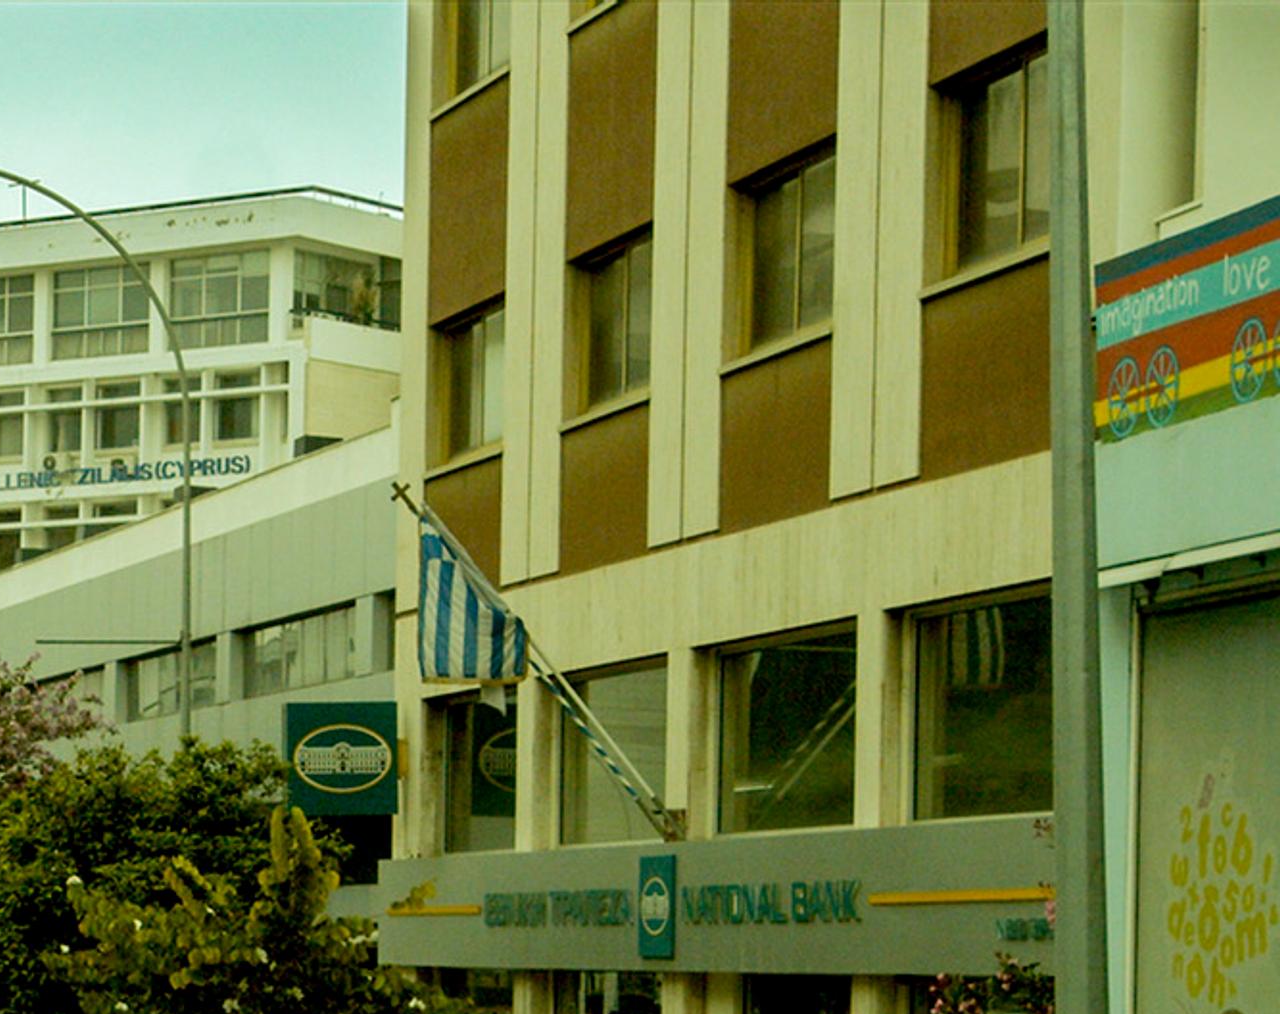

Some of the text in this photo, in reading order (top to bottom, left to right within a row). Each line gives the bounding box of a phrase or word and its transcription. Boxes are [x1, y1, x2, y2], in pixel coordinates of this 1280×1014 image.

[1099, 254, 1271, 337] imagination love
[681, 879, 863, 925] NATIONAL BANK
